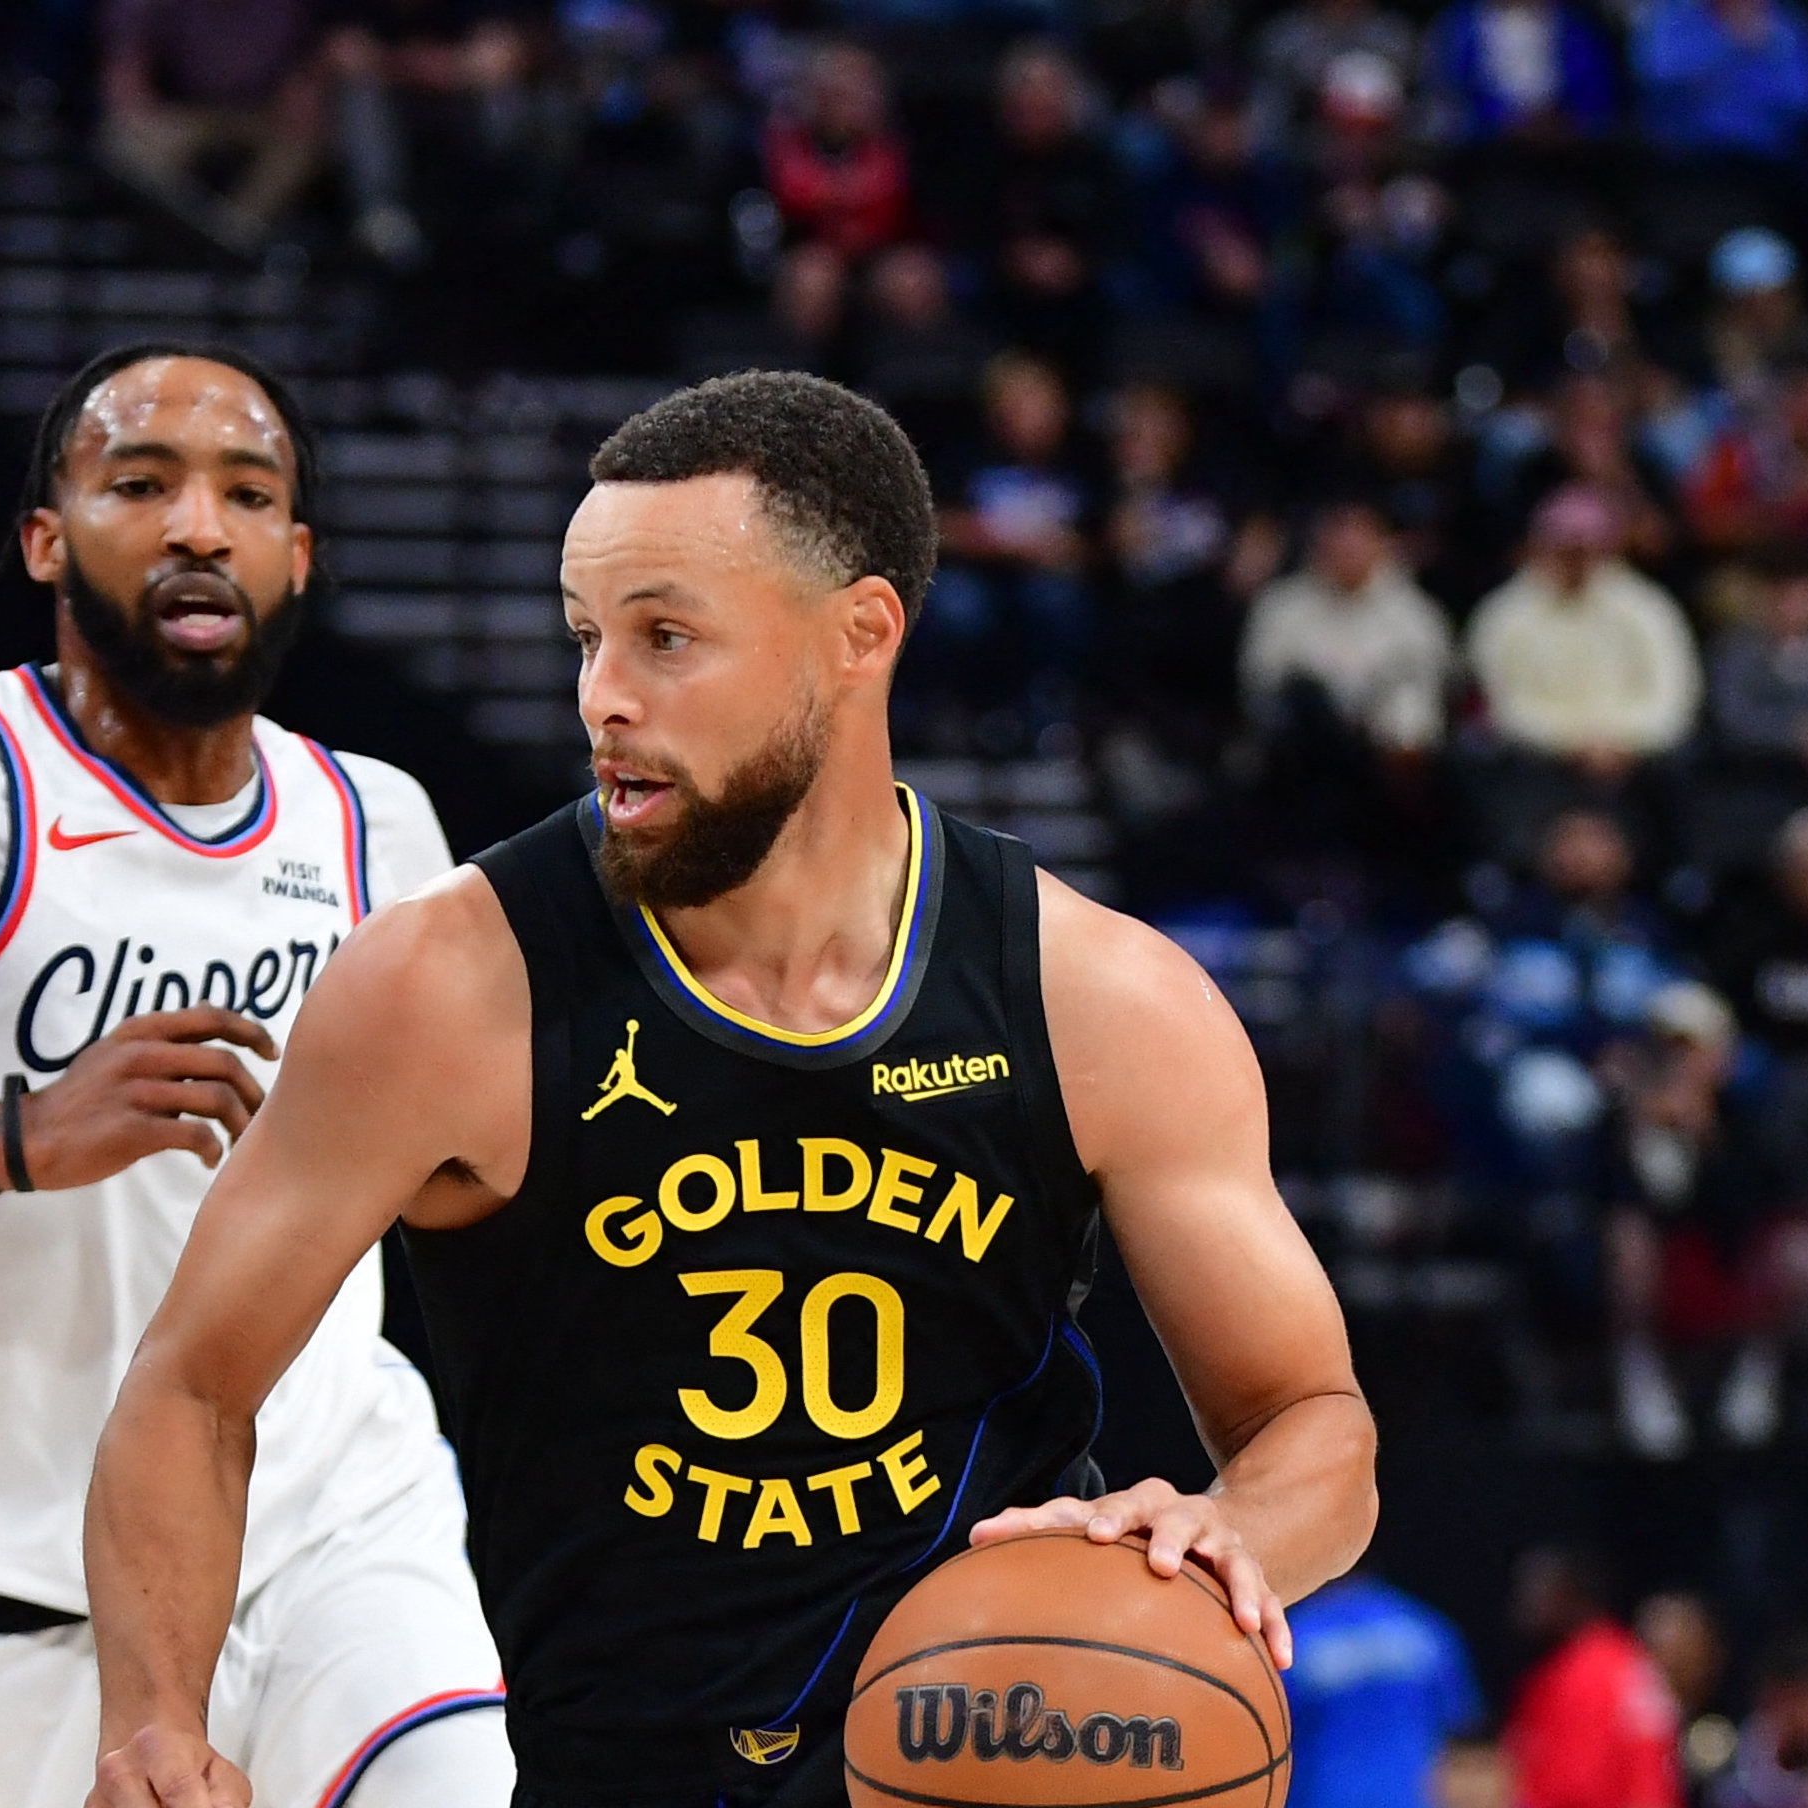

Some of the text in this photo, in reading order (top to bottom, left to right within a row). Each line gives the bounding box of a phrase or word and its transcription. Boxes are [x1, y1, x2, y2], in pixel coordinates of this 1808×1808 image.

[262, 876, 339, 908] RWANDA
[277, 858, 321, 881] VISIT
[872, 1053, 1011, 1096] Rakuten
[585, 1137, 1015, 1268] GOLDEN
[677, 1269, 905, 1440] 30
[623, 1430, 941, 1549] STATE
[895, 1681, 1185, 1772] Wilson
